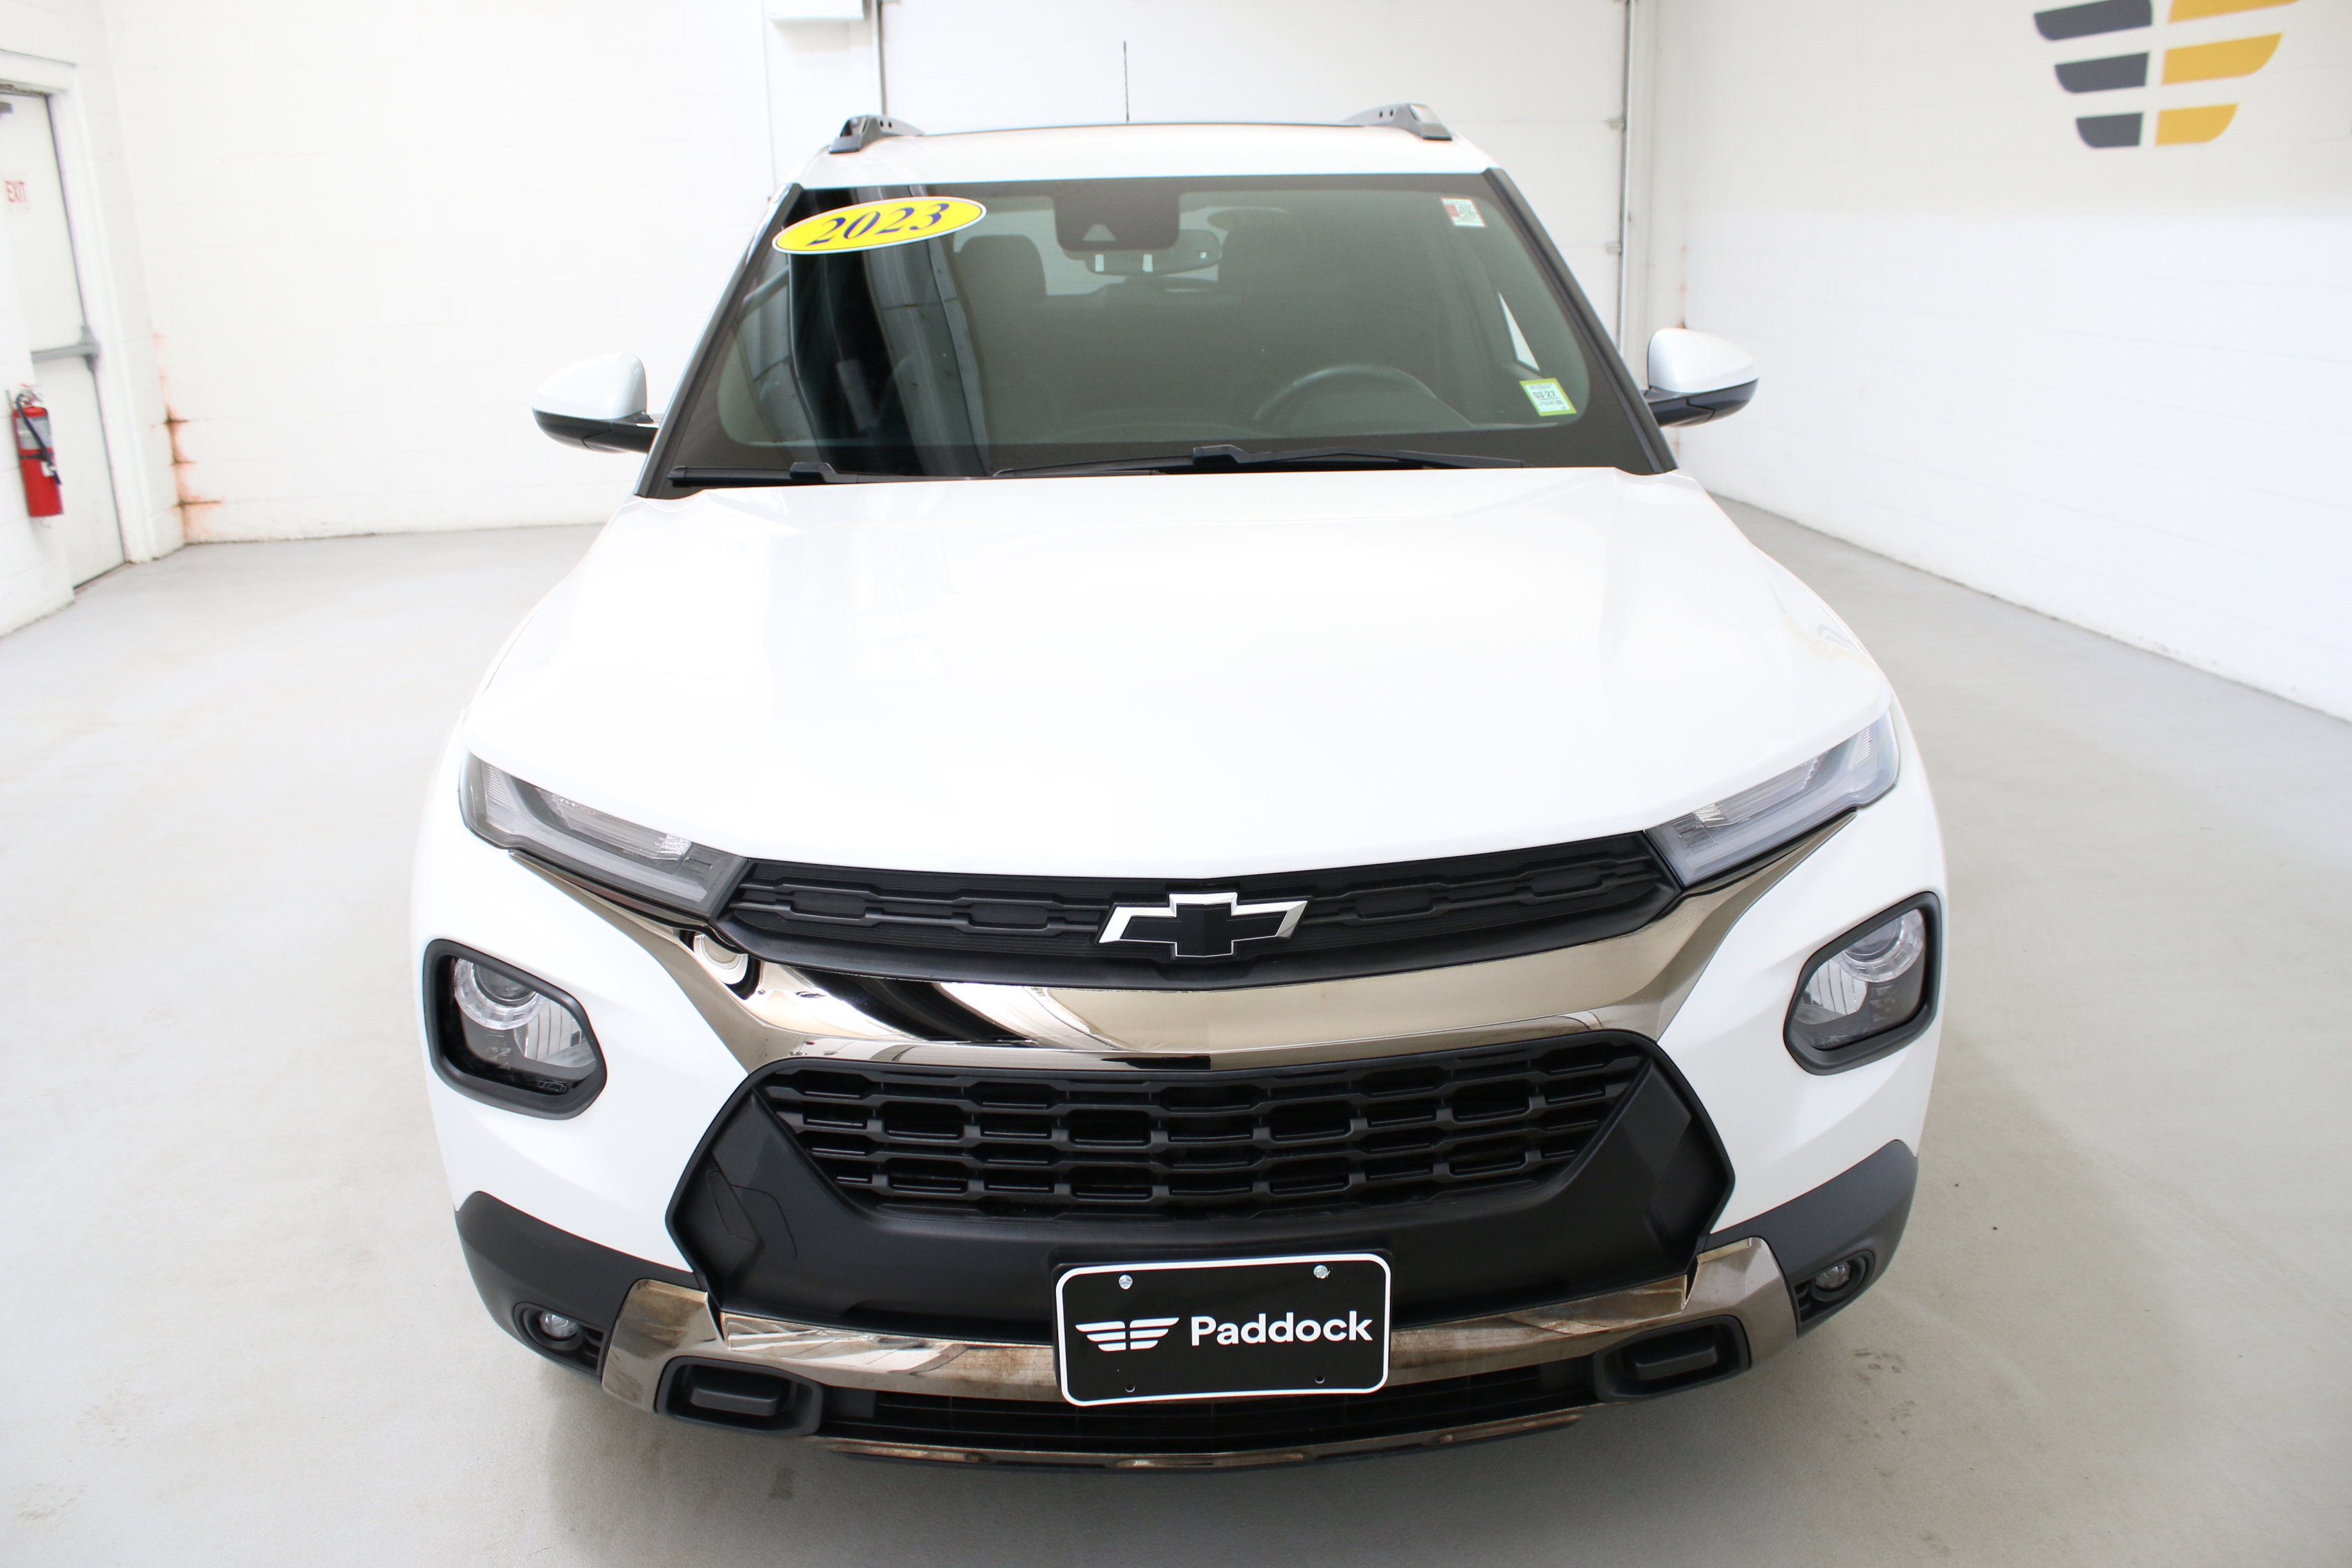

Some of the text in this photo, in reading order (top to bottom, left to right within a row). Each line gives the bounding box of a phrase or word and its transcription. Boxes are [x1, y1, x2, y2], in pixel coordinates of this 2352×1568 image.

[6, 181, 27, 203] EXIT
[805, 202, 950, 246] 2023
[1190, 1310, 1374, 1347] Paddock
